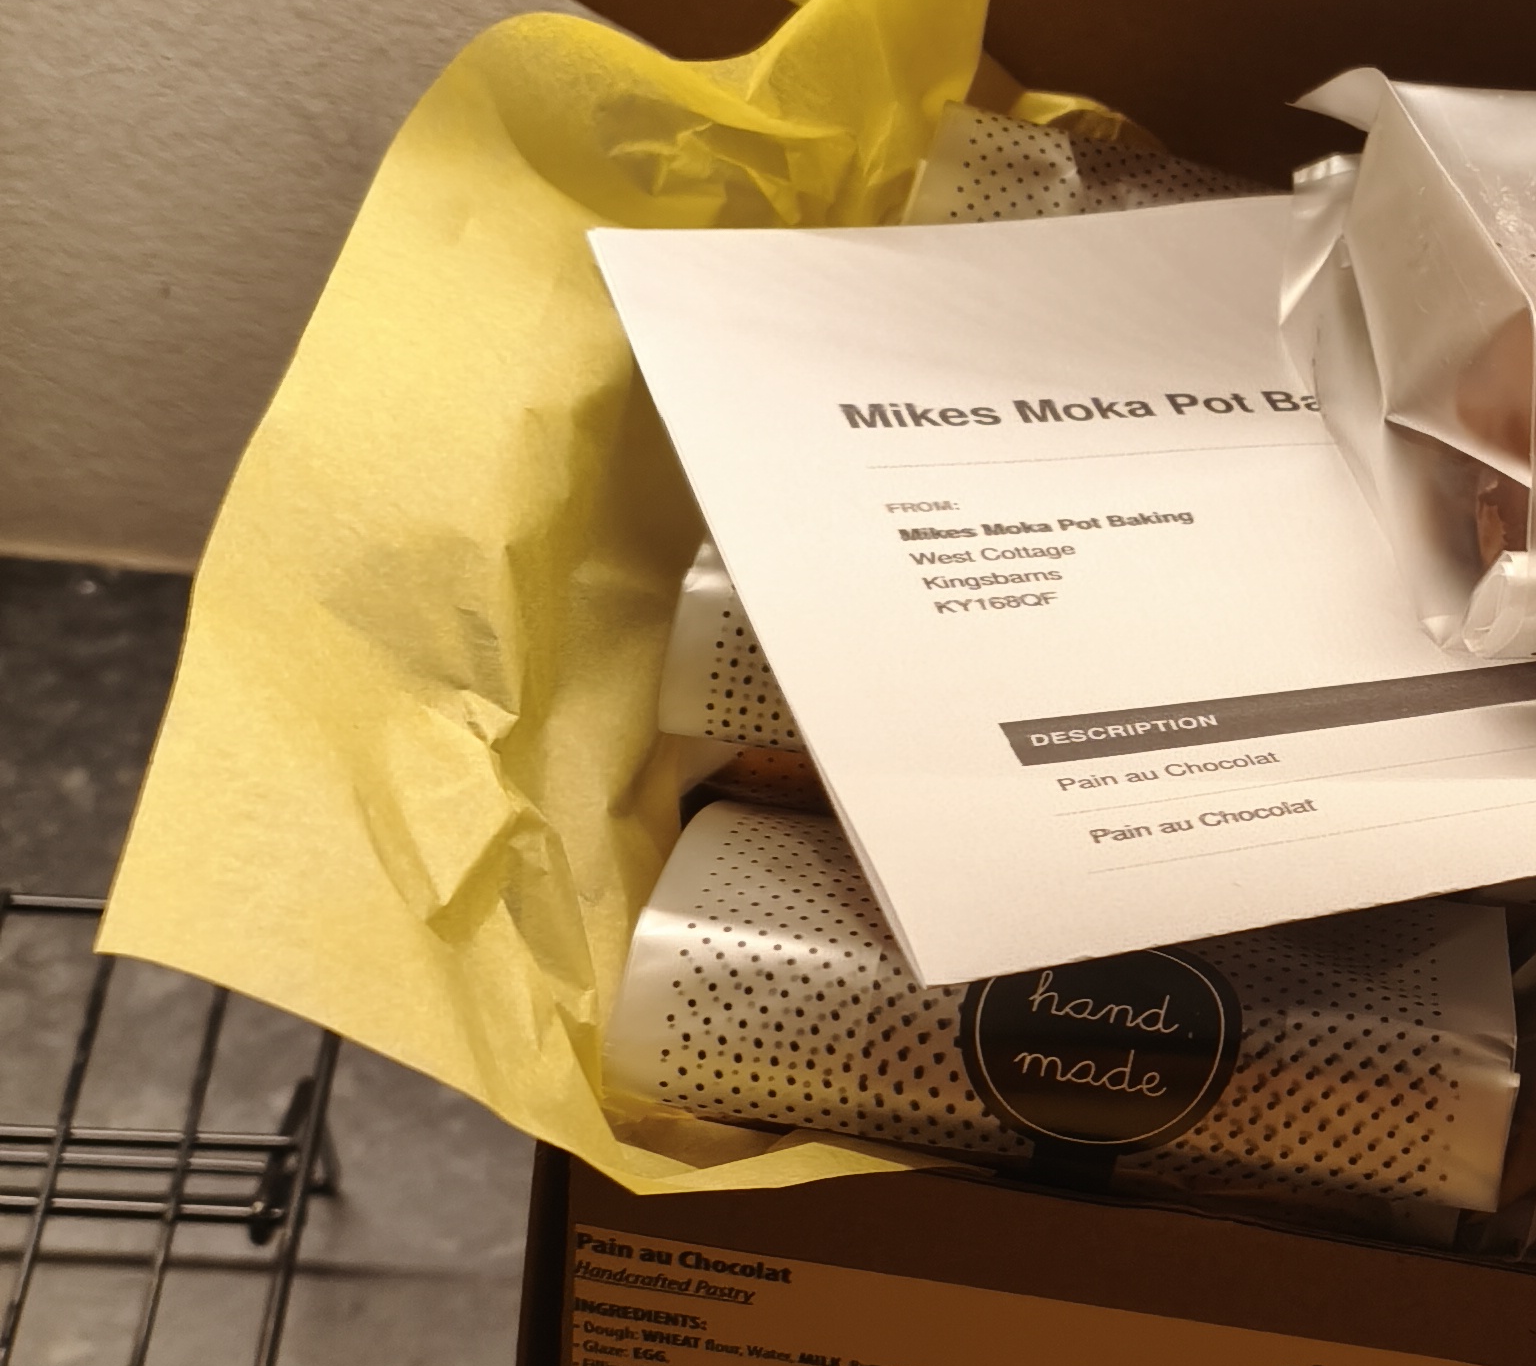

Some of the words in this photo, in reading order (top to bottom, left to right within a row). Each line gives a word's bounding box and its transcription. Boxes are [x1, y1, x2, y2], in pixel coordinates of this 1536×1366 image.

[837, 402, 1002, 430] Mikes
[1011, 395, 1157, 425] Moka
[1164, 390, 1254, 416] Pot
[884, 500, 961, 514] FROM:
[898, 526, 979, 542] Mikes
[981, 521, 1054, 537] Moka
[1057, 516, 1103, 532] Pot
[1105, 511, 1195, 528] Baking
[909, 550, 977, 566] West
[980, 543, 1077, 560] Cottage
[922, 568, 1064, 591] Kingsbarns
[933, 591, 1060, 615] KY168QF
[1029, 713, 1219, 748] DESCRIPTION
[1056, 774, 1119, 792] Pain
[1126, 767, 1160, 784] au
[1163, 750, 1281, 777] Chocolat
[1088, 824, 1154, 844] Pain
[1159, 817, 1195, 834] au
[1198, 798, 1319, 827] Chocolat
[1027, 969, 1180, 1034] hand
[1012, 1048, 1168, 1097] made
[576, 1231, 634, 1260] Pain
[639, 1246, 673, 1266] au
[677, 1250, 793, 1285] Chocolat
[574, 1259, 693, 1292] Handcrafted
[694, 1278, 757, 1304] Pastry
[574, 1296, 708, 1332] INGREDIENTS:
[641, 1328, 702, 1349] WHEAT
